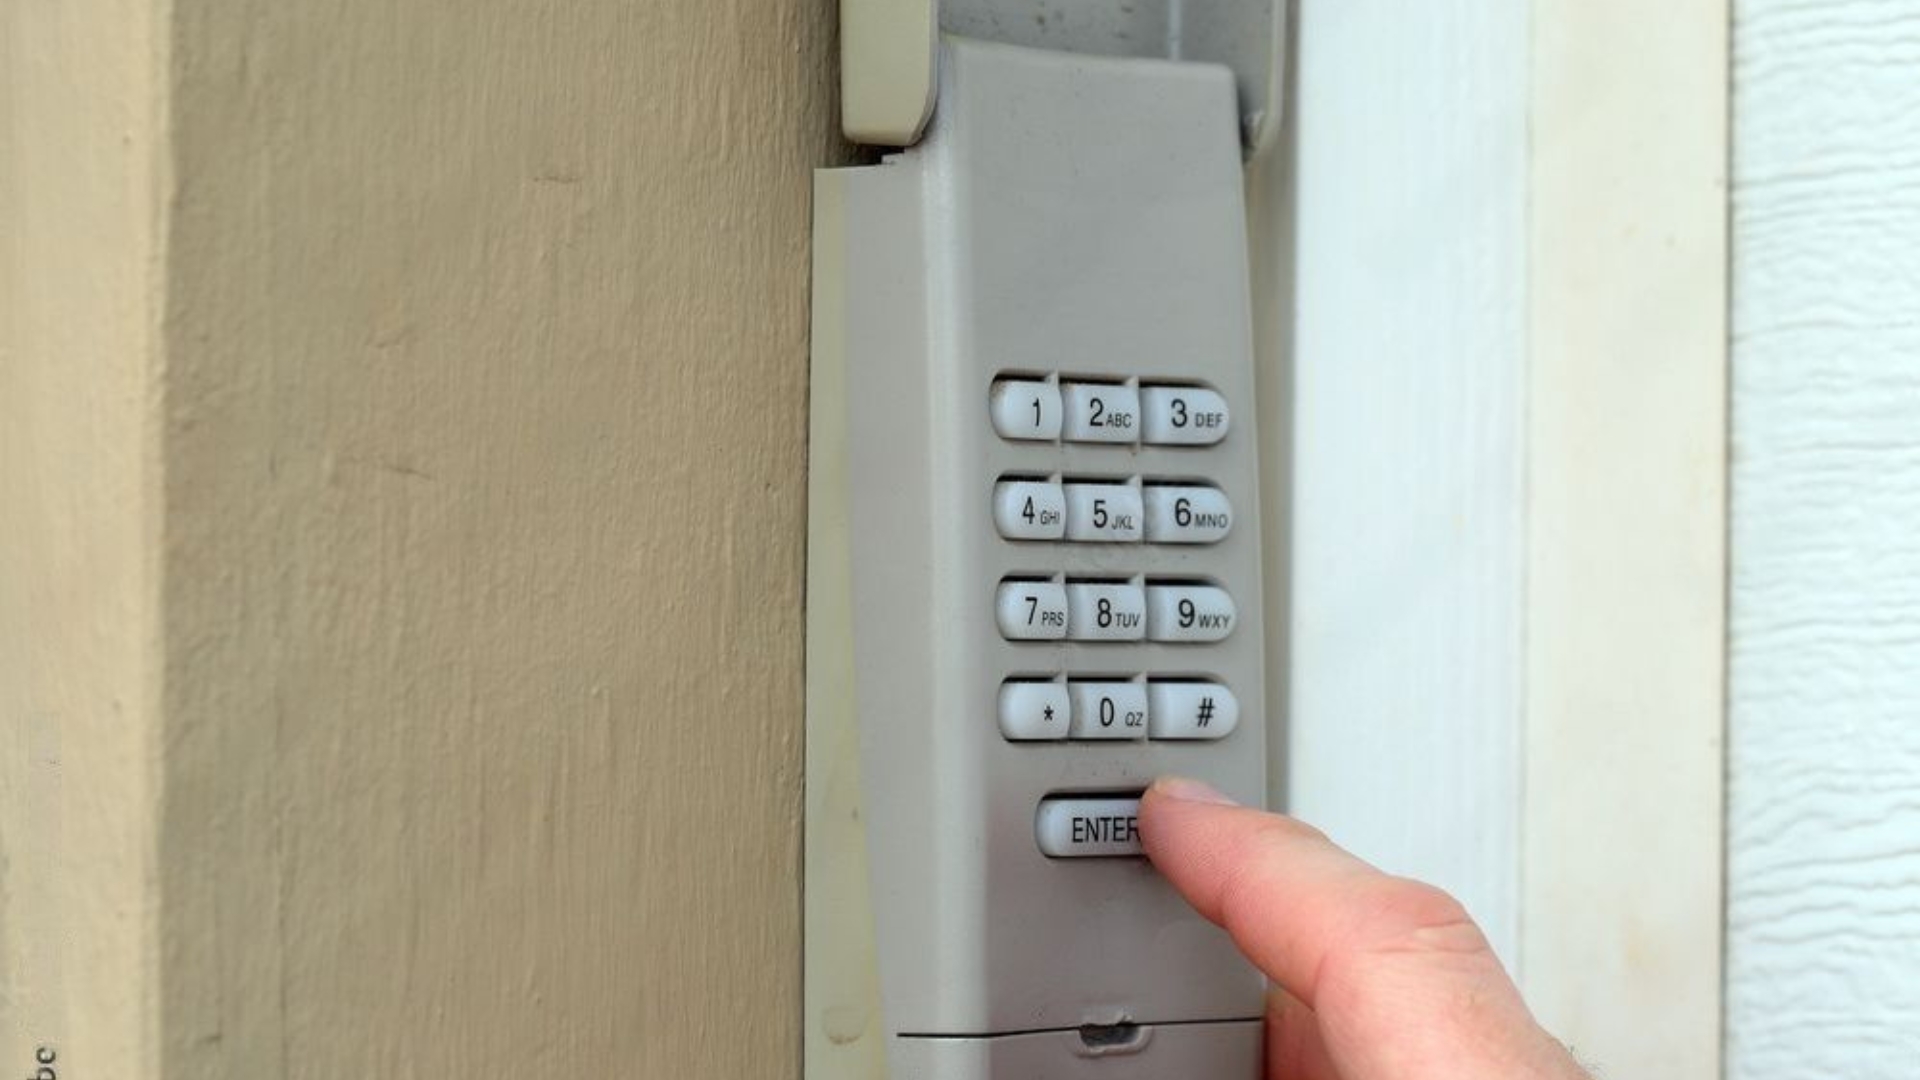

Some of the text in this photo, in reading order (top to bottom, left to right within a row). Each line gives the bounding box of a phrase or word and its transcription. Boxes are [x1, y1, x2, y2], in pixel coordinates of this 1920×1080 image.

[1032, 397, 1041, 427] 1
[1089, 397, 1132, 429] 2 ABC
[1170, 398, 1224, 428] 3 DEF
[1022, 496, 1060, 525] 4 GHI
[1093, 499, 1135, 530] 5 JKL
[1174, 498, 1228, 528] 6 MNO
[1025, 596, 1064, 627] 7 PRS
[1097, 598, 1141, 628] 8 TUV
[1178, 598, 1230, 629] 9 WXY
[1100, 697, 1143, 727] 0 QZ
[1197, 697, 1215, 727] #
